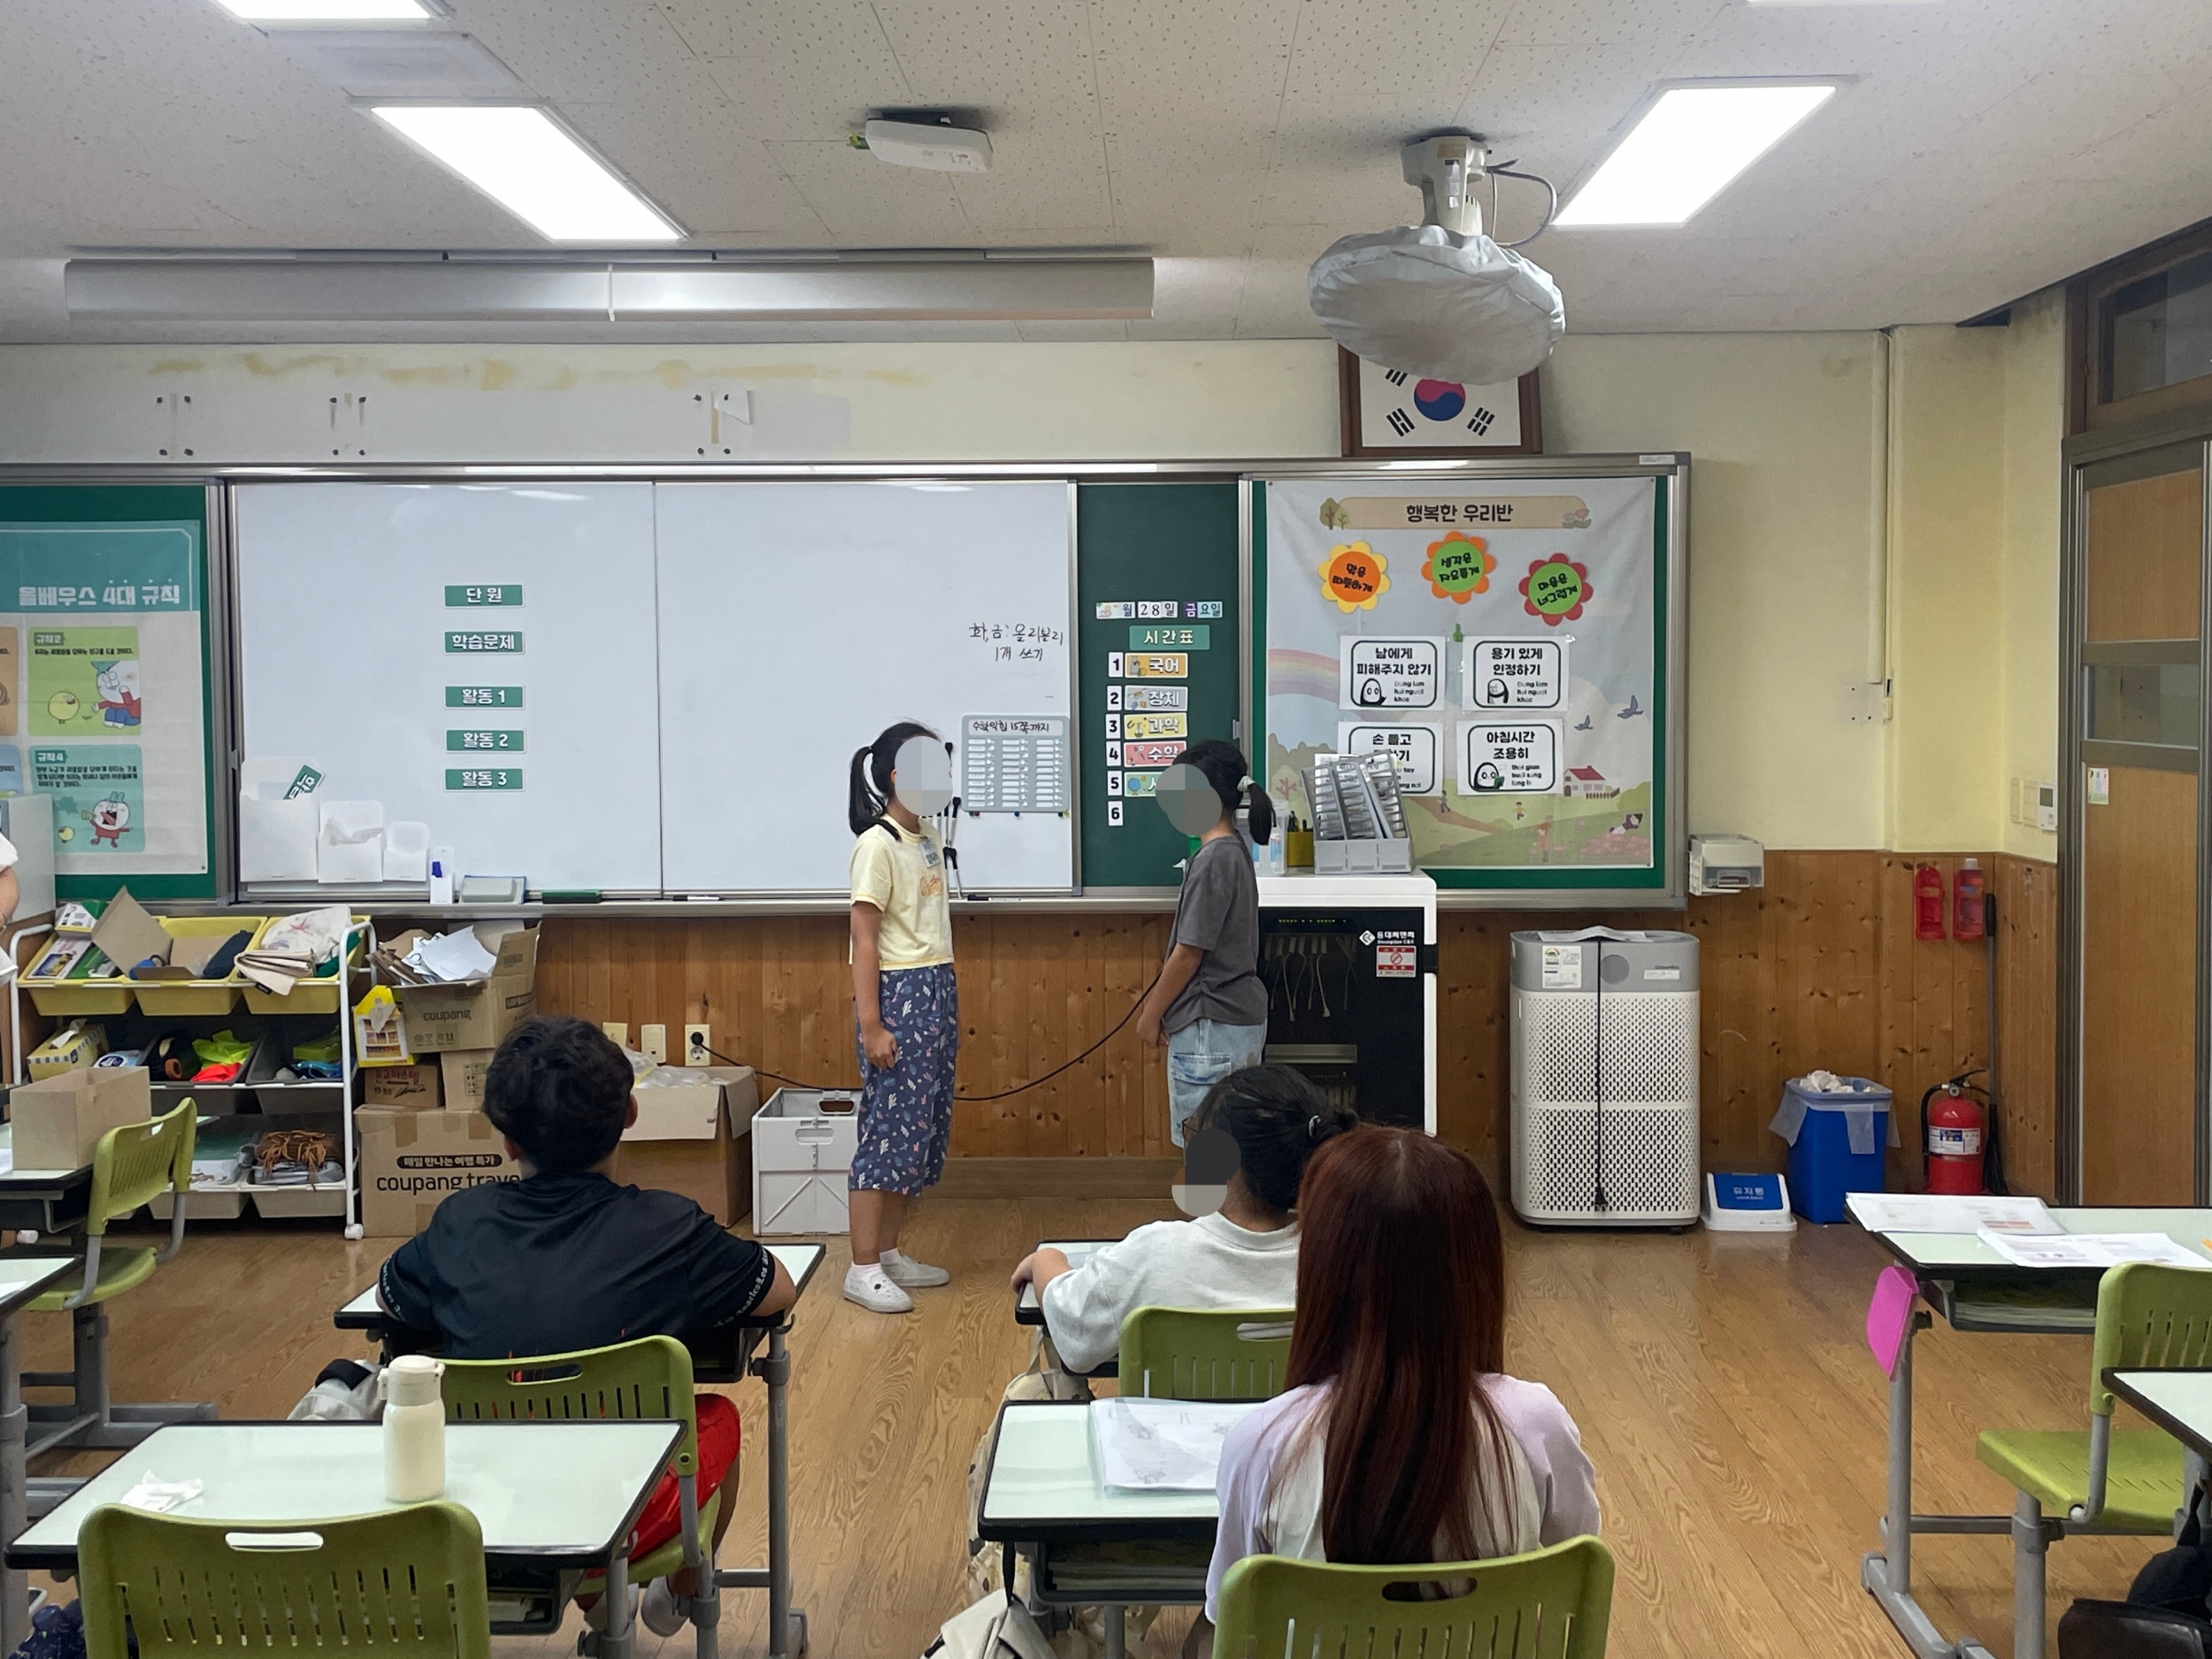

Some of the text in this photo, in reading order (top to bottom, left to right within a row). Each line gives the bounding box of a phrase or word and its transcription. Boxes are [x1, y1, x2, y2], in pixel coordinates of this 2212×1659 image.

[1406, 503, 1514, 523] 행복한 우리반
[1537, 572, 1568, 591] 마음은
[103, 586, 136, 605] 4대
[142, 584, 180, 605] 규칙
[1537, 585, 1578, 606] 너그럽게
[1140, 603, 1175, 617] 28일
[1185, 603, 1221, 617] 금요일
[451, 634, 515, 650] 학습문제
[1144, 629, 1194, 644] 시간표
[1018, 648, 1043, 662] 쓰기
[1376, 648, 1413, 659] 남에게
[1491, 648, 1543, 659] 용기 있게
[1112, 657, 1179, 673] 1 국어
[1356, 664, 1432, 676] 피해주지 않기
[1494, 664, 1540, 676] 인정하기
[462, 688, 505, 705] 활동 1
[1110, 690, 1179, 707] 2 창체
[1109, 718, 1179, 733] 3 과학
[463, 732, 509, 749] 활동 2
[1372, 733, 1384, 745] 손
[1486, 731, 1535, 744] 아침시간
[1109, 745, 1179, 762] 4 수학
[1493, 748, 1529, 760] 조용히
[461, 771, 507, 787] 활동 3
[1110, 777, 1119, 789] 5
[1111, 807, 1120, 819] 6
[423, 1010, 472, 1023] coupang
[425, 1156, 453, 1167] 만나는
[455, 1156, 473, 1166] 여행
[376, 1175, 463, 1195] coupang
